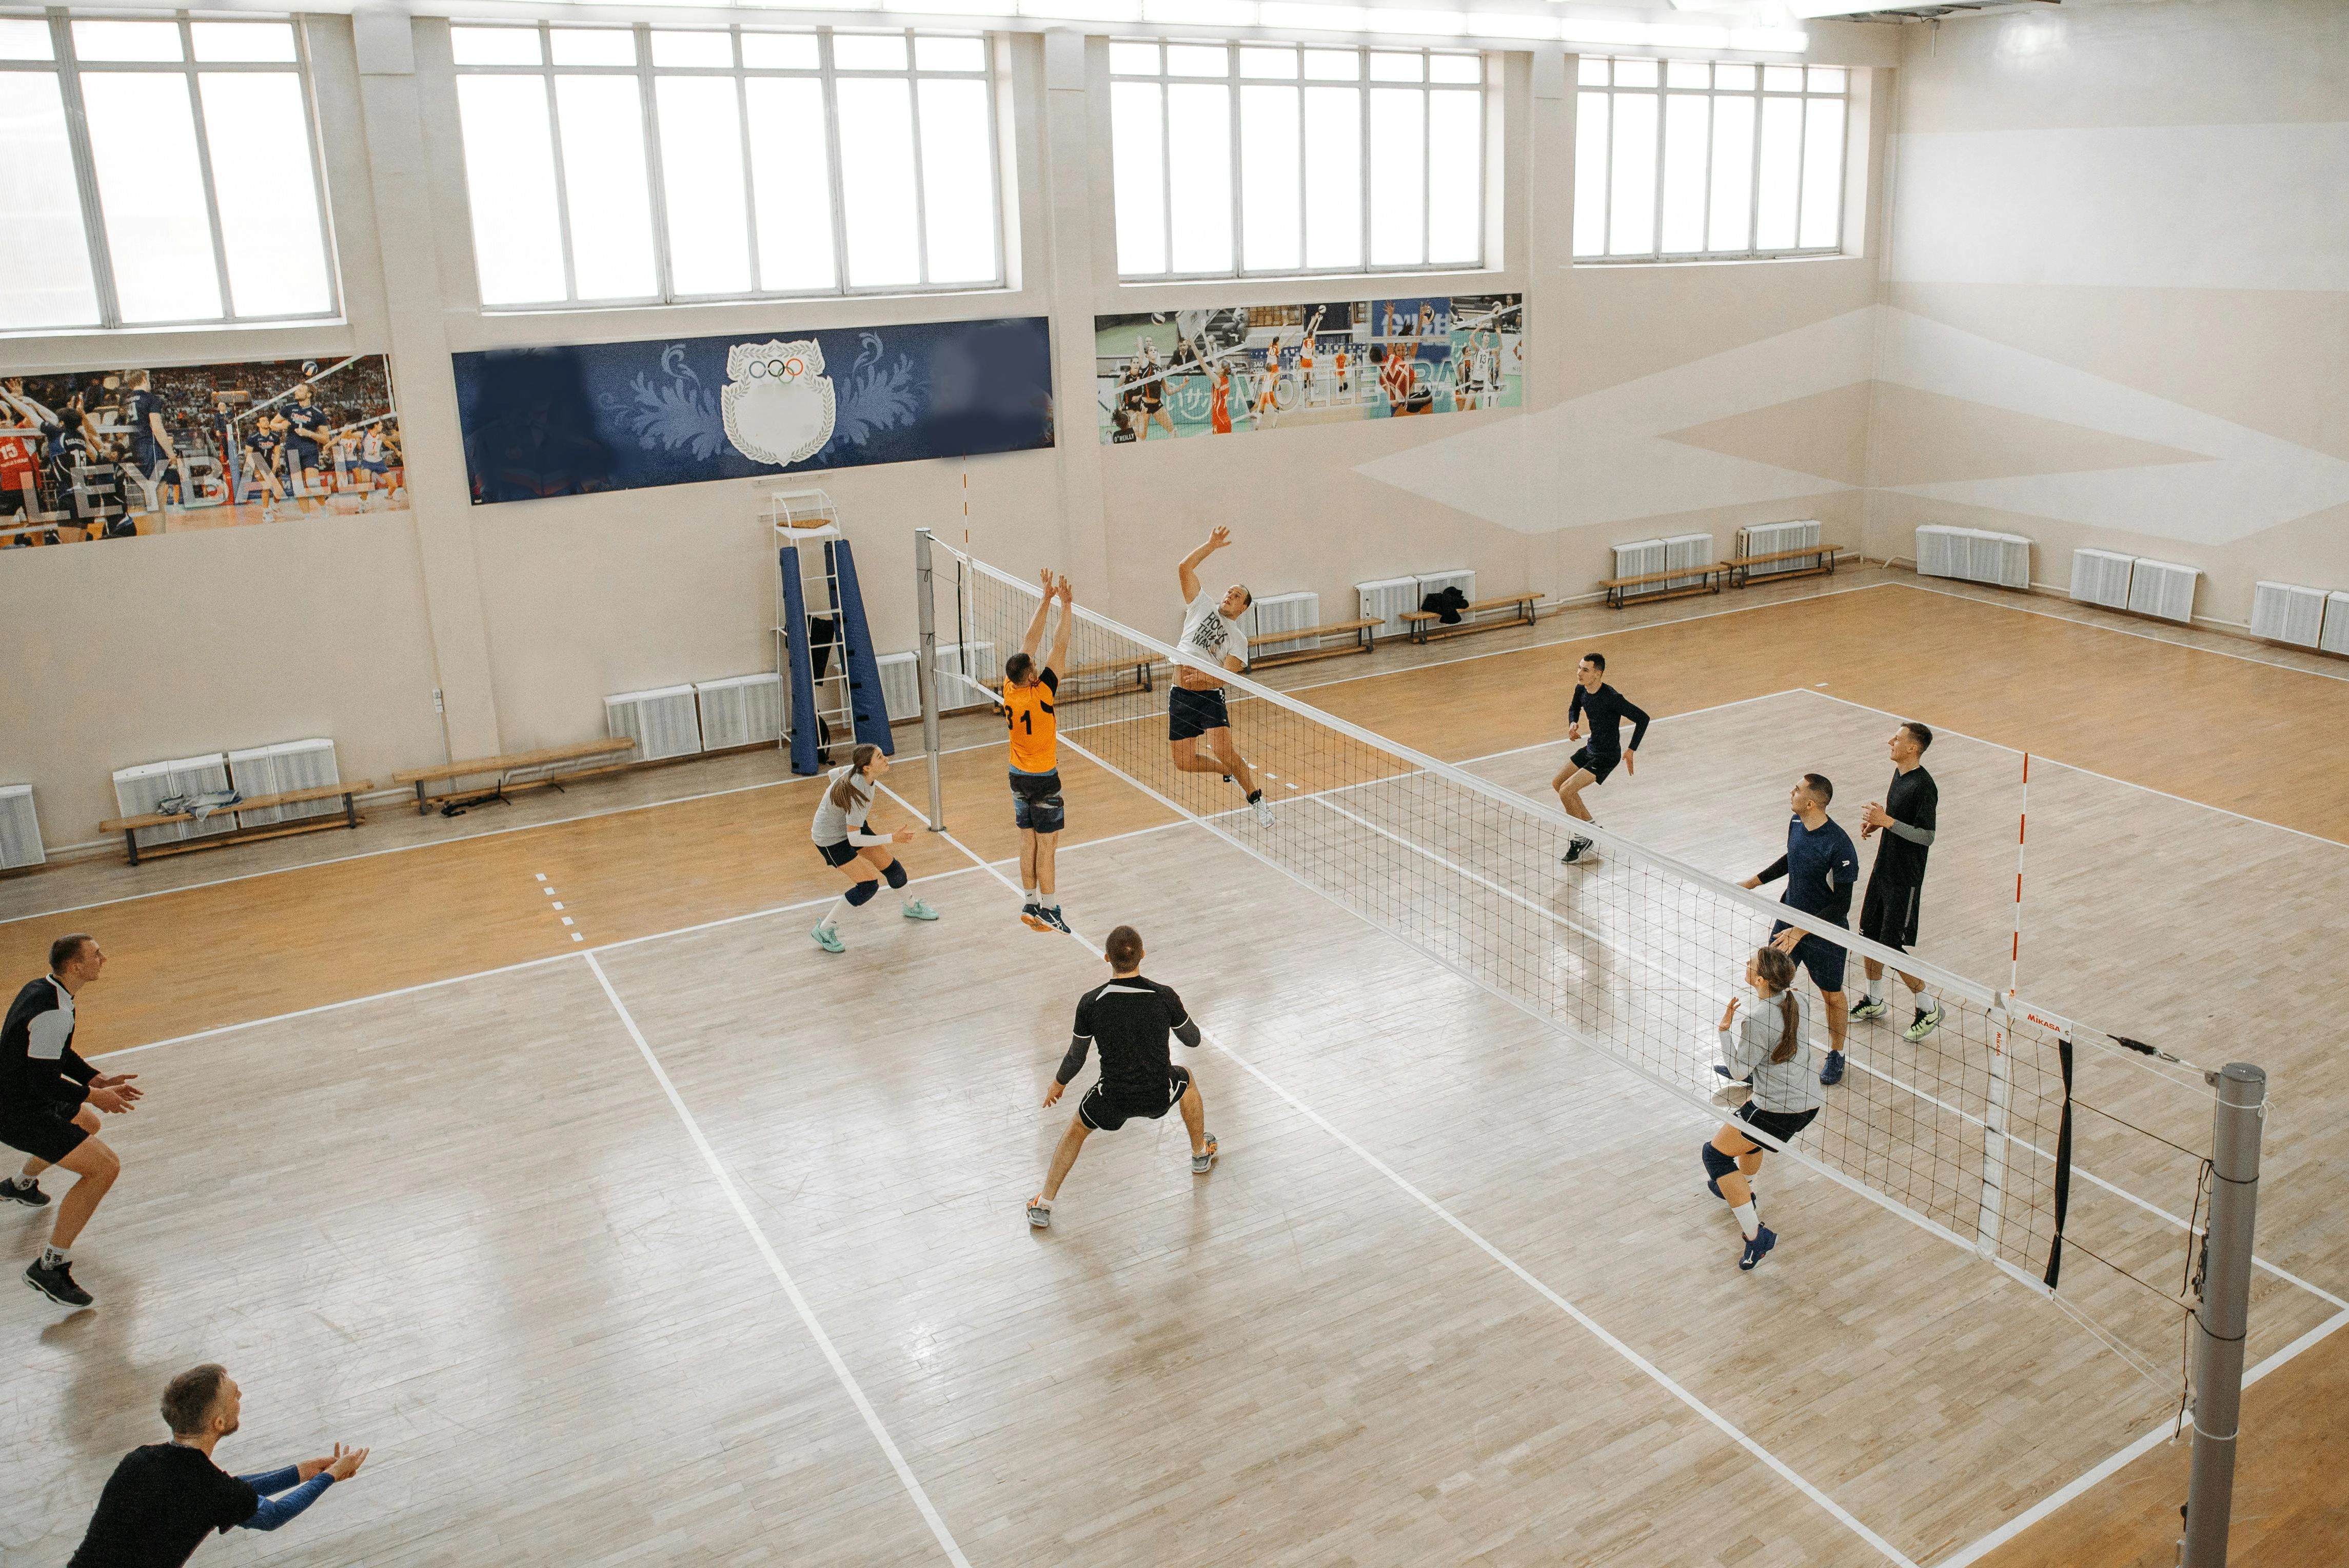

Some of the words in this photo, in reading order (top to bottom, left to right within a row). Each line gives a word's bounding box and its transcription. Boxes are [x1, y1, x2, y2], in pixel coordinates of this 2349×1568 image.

[1479, 354, 1487, 364] 13
[1114, 433, 1134, 443] O'REILLY
[0, 443, 18, 460] 15
[1192, 632, 1211, 650] WAY
